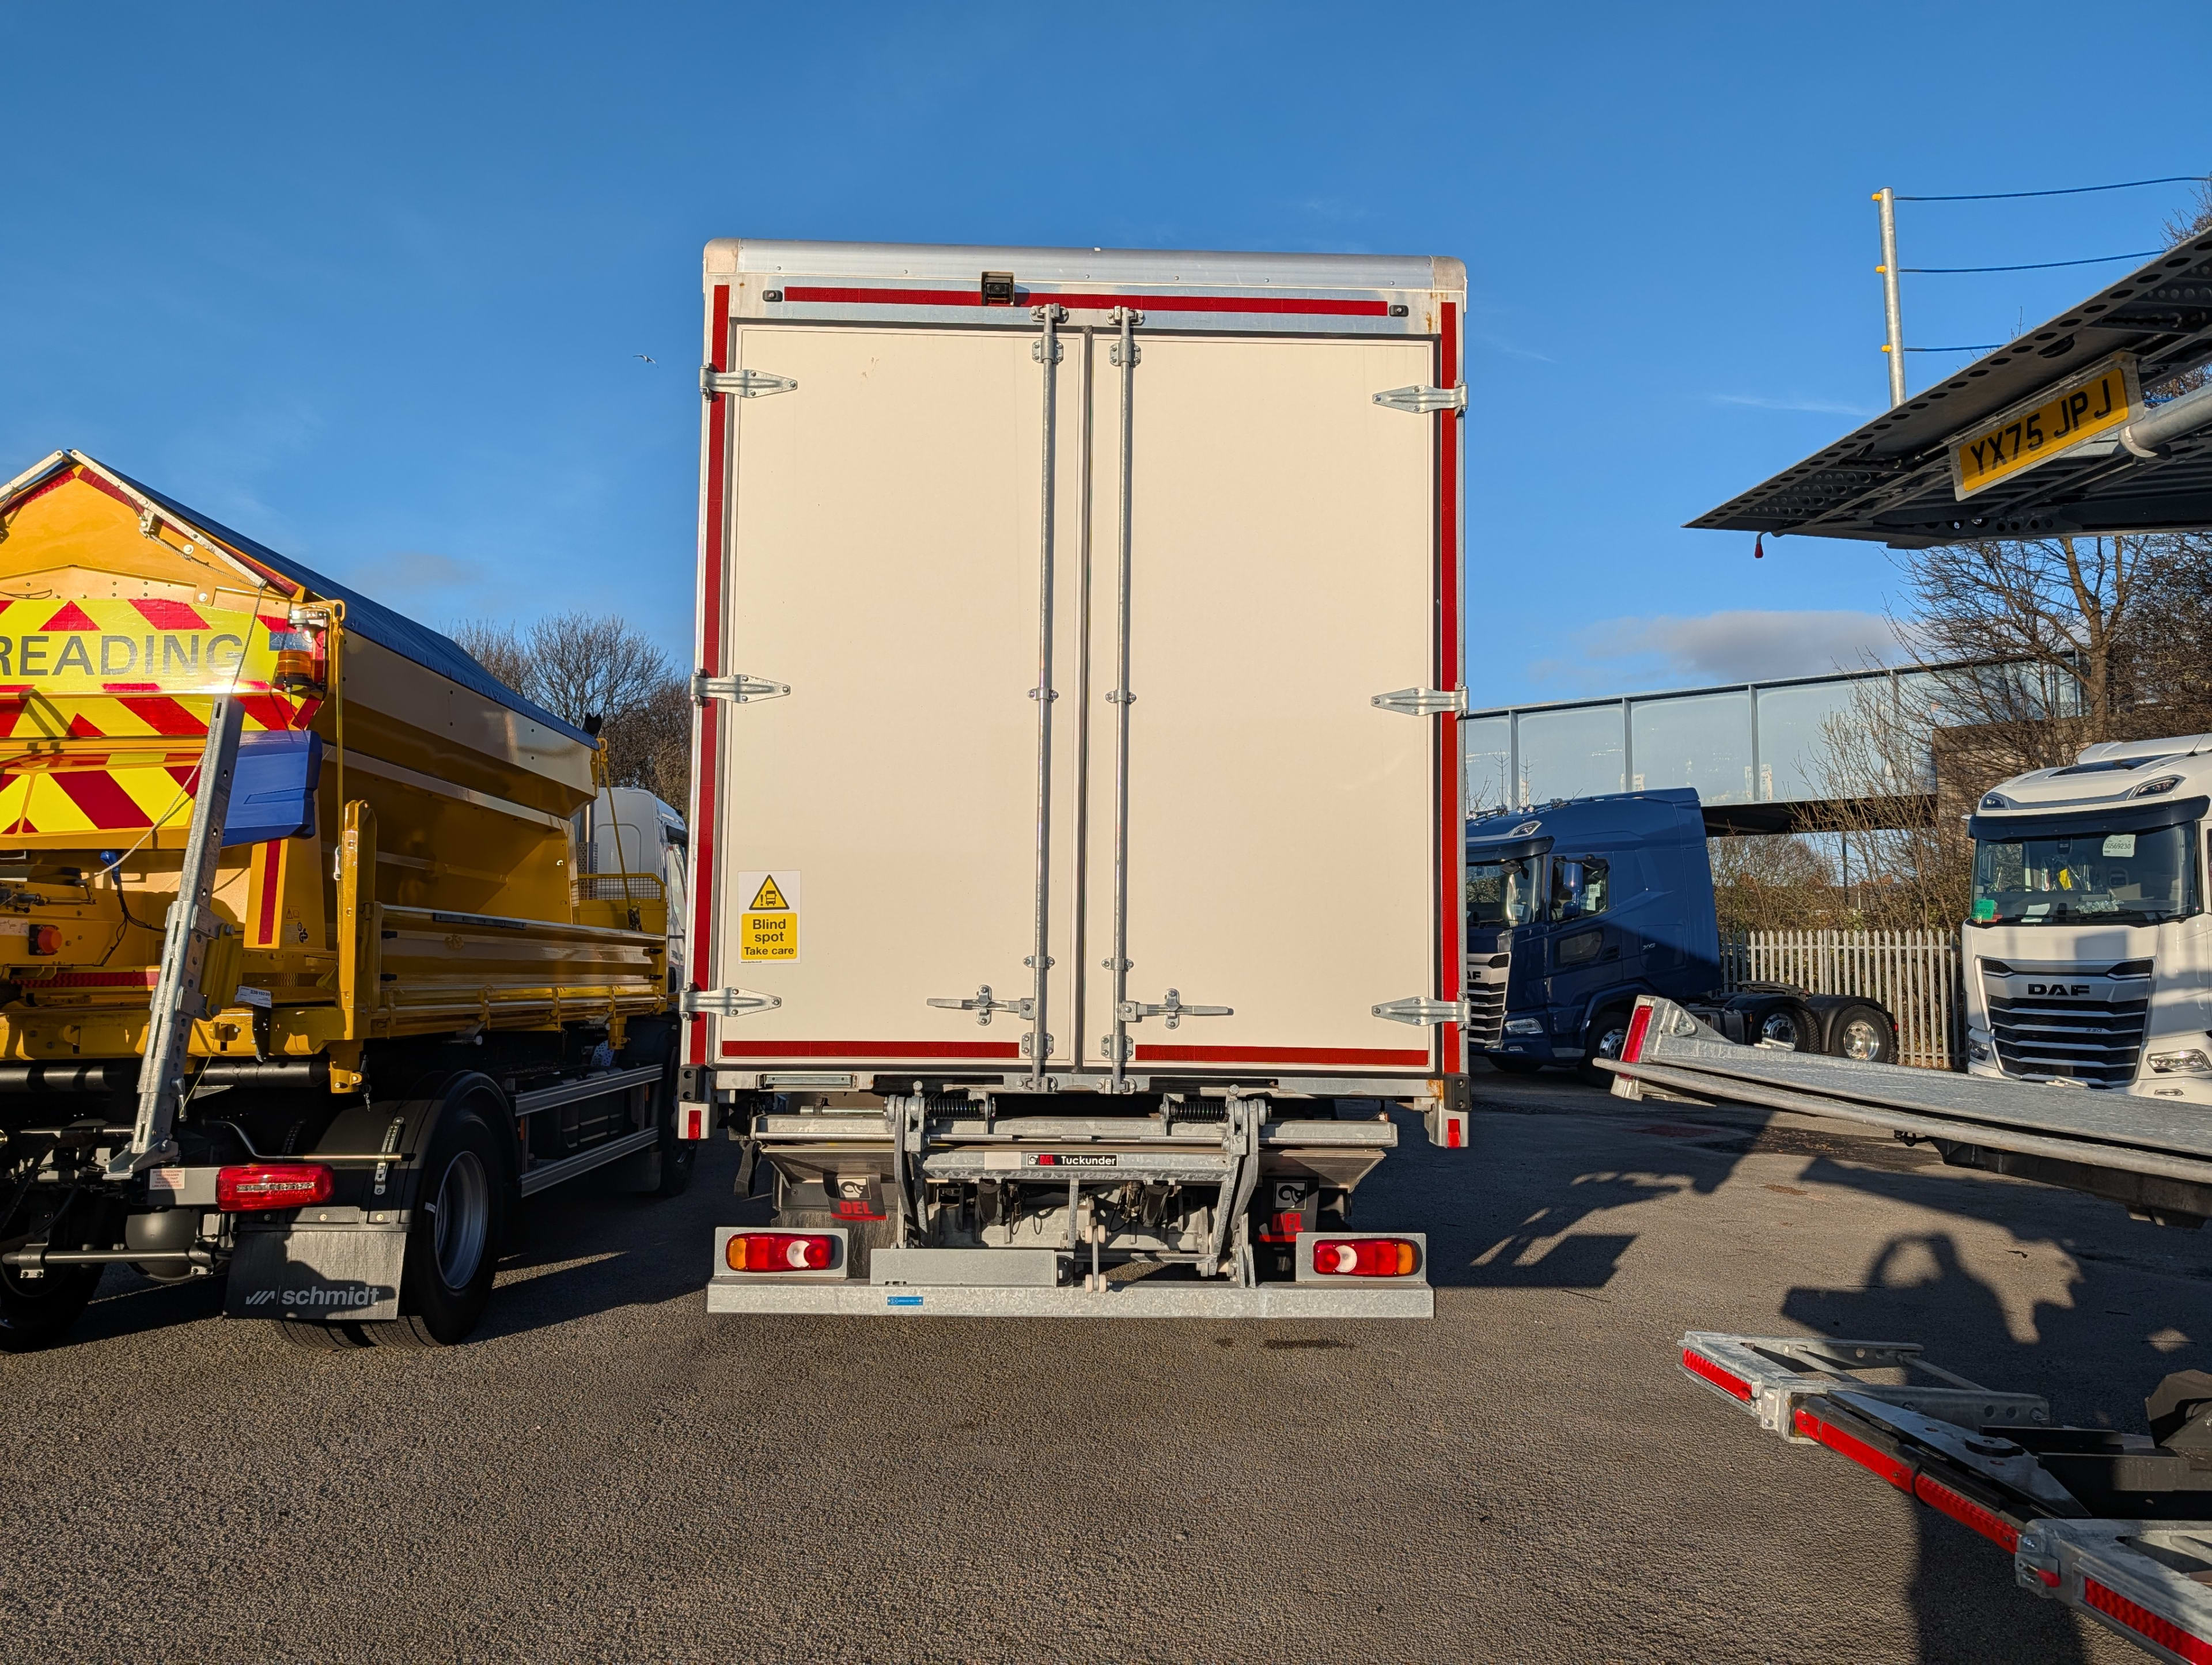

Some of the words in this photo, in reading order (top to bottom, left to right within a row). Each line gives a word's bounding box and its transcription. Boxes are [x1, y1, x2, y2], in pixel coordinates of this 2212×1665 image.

[1970, 413, 2044, 476] YX75
[2054, 379, 2112, 439] JPJ
[752, 919, 786, 930] Blind
[754, 932, 785, 945] spot
[744, 946, 768, 955] Take
[1467, 970, 1481, 980] AF
[2028, 984, 2090, 996] DAF
[1039, 1155, 1055, 1165] DEL
[1060, 1155, 1116, 1165] Tuckunder
[839, 1201, 873, 1214] DEL
[1272, 1212, 1304, 1232] DEL
[281, 1286, 380, 1306] schmidt
